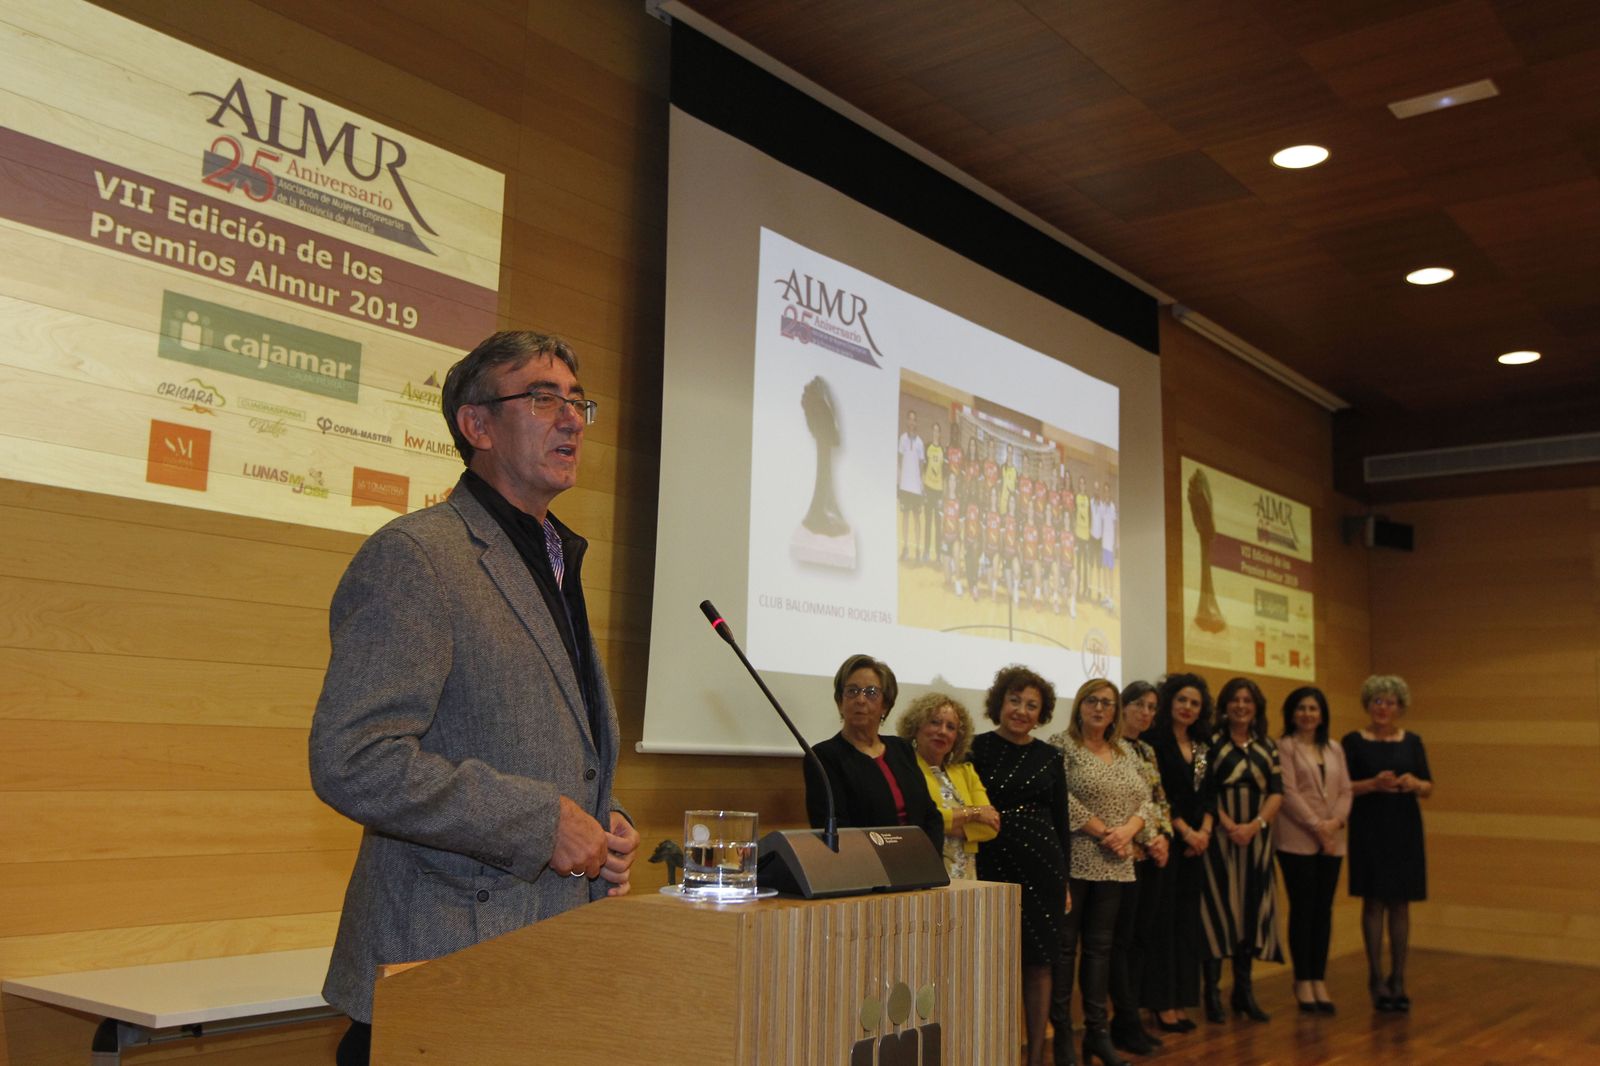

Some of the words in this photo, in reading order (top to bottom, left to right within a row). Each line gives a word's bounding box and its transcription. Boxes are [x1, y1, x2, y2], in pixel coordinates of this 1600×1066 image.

[189, 77, 438, 236] ALMUR
[287, 159, 392, 211] Aniversario
[94, 170, 155, 214] VII
[168, 195, 286, 255] Edición
[296, 239, 333, 270] de
[343, 251, 383, 285] los
[299, 198, 334, 219] Provincia
[335, 211, 346, 223] de
[320, 192, 332, 203] de
[332, 197, 362, 217] Mujeres
[362, 208, 405, 231] Empresarias
[90, 211, 236, 277] Premios
[245, 260, 341, 307] Almur
[350, 290, 418, 330] 2019
[774, 268, 884, 357] ALMUR
[814, 316, 862, 343] Aniversario
[223, 333, 352, 379] cajamar
[333, 424, 393, 444] COPIA-MASTER
[758, 594, 783, 610] CLUB
[785, 598, 845, 619] BALONMANO
[847, 607, 893, 625] ROQUETAS
